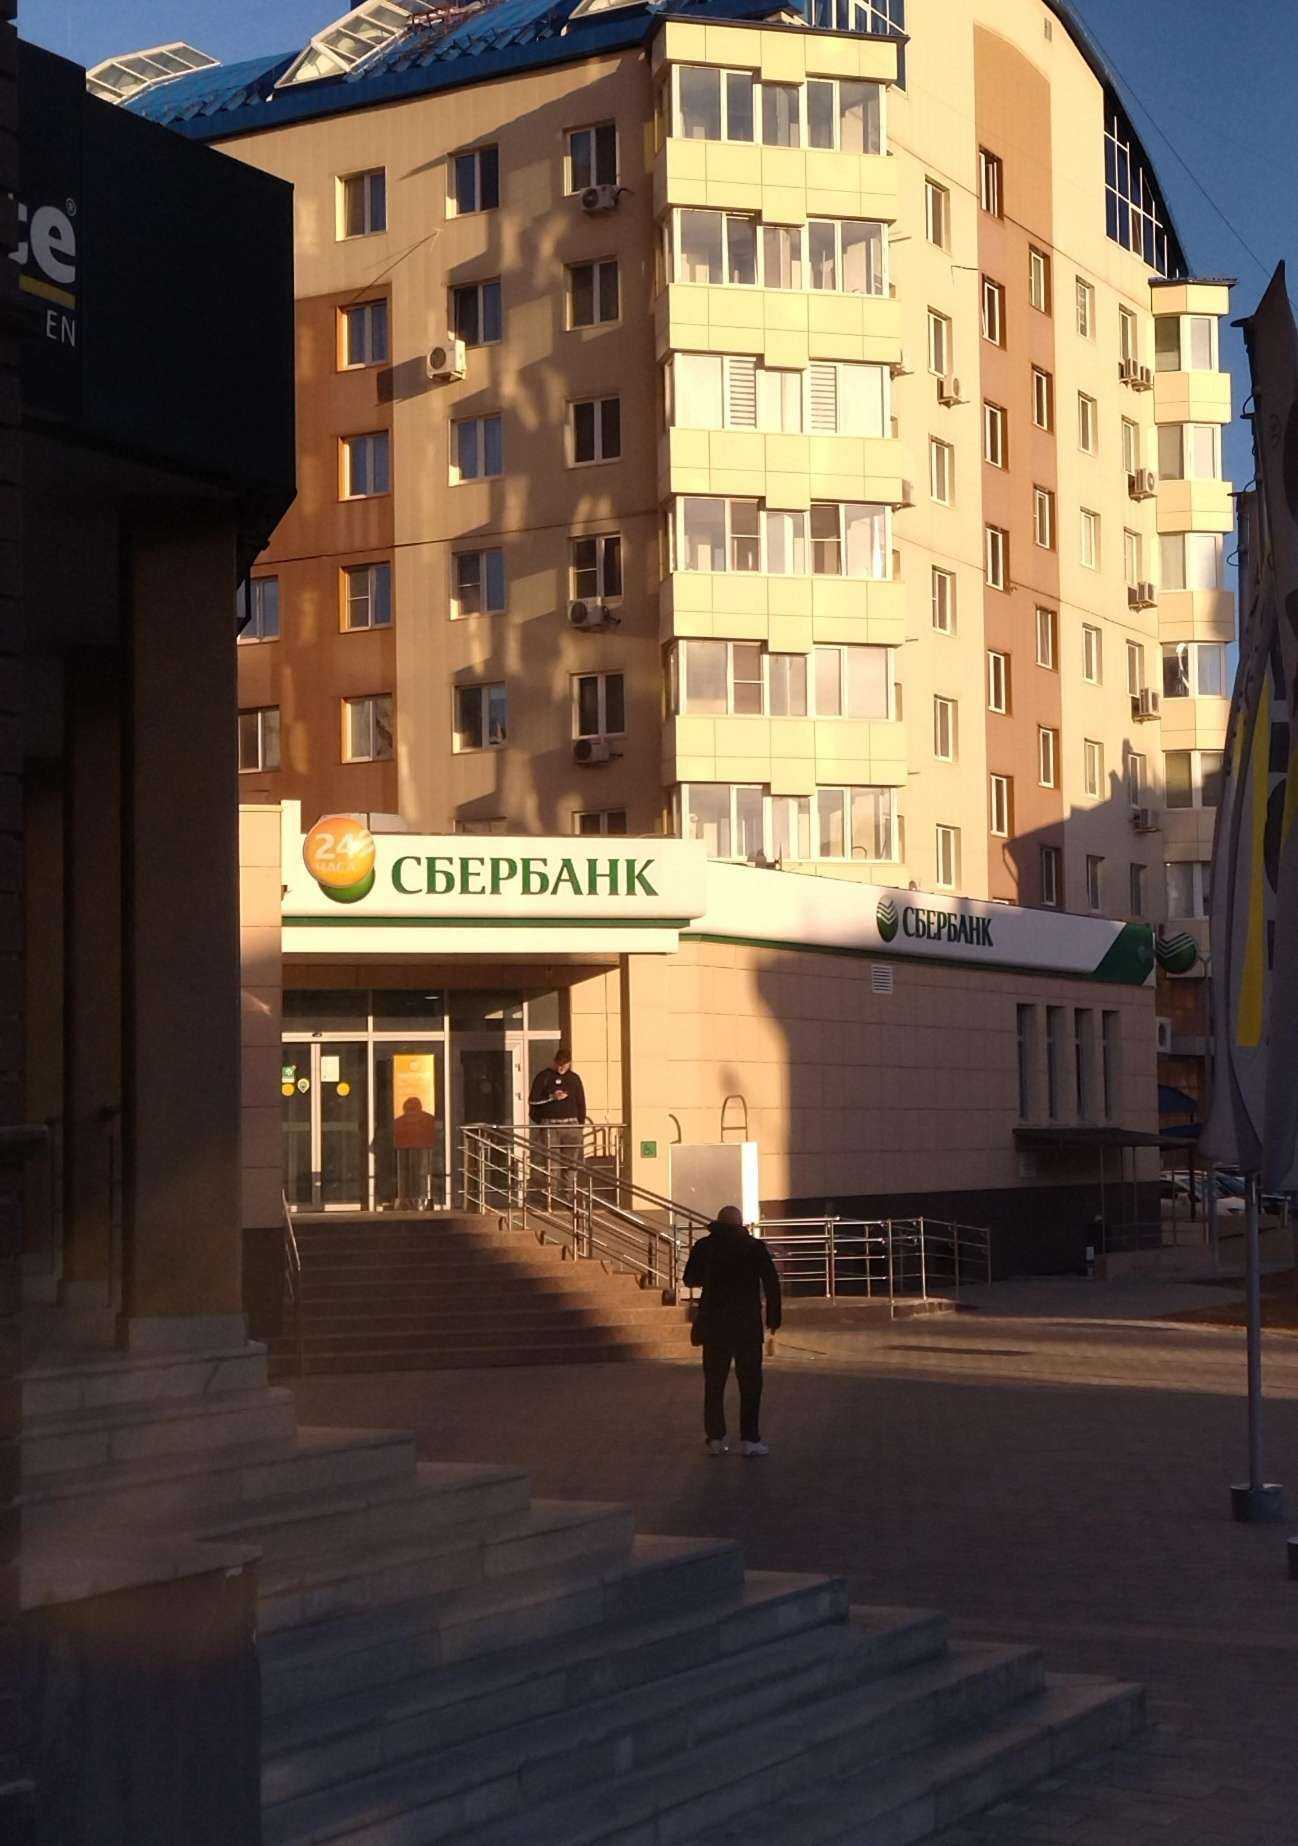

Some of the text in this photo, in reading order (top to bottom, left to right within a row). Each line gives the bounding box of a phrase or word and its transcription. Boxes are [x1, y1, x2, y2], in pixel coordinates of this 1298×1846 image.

[314, 832, 357, 860] 24
[391, 855, 659, 897] СБЕРБАНК
[902, 906, 994, 947] СБЕРБАНК
